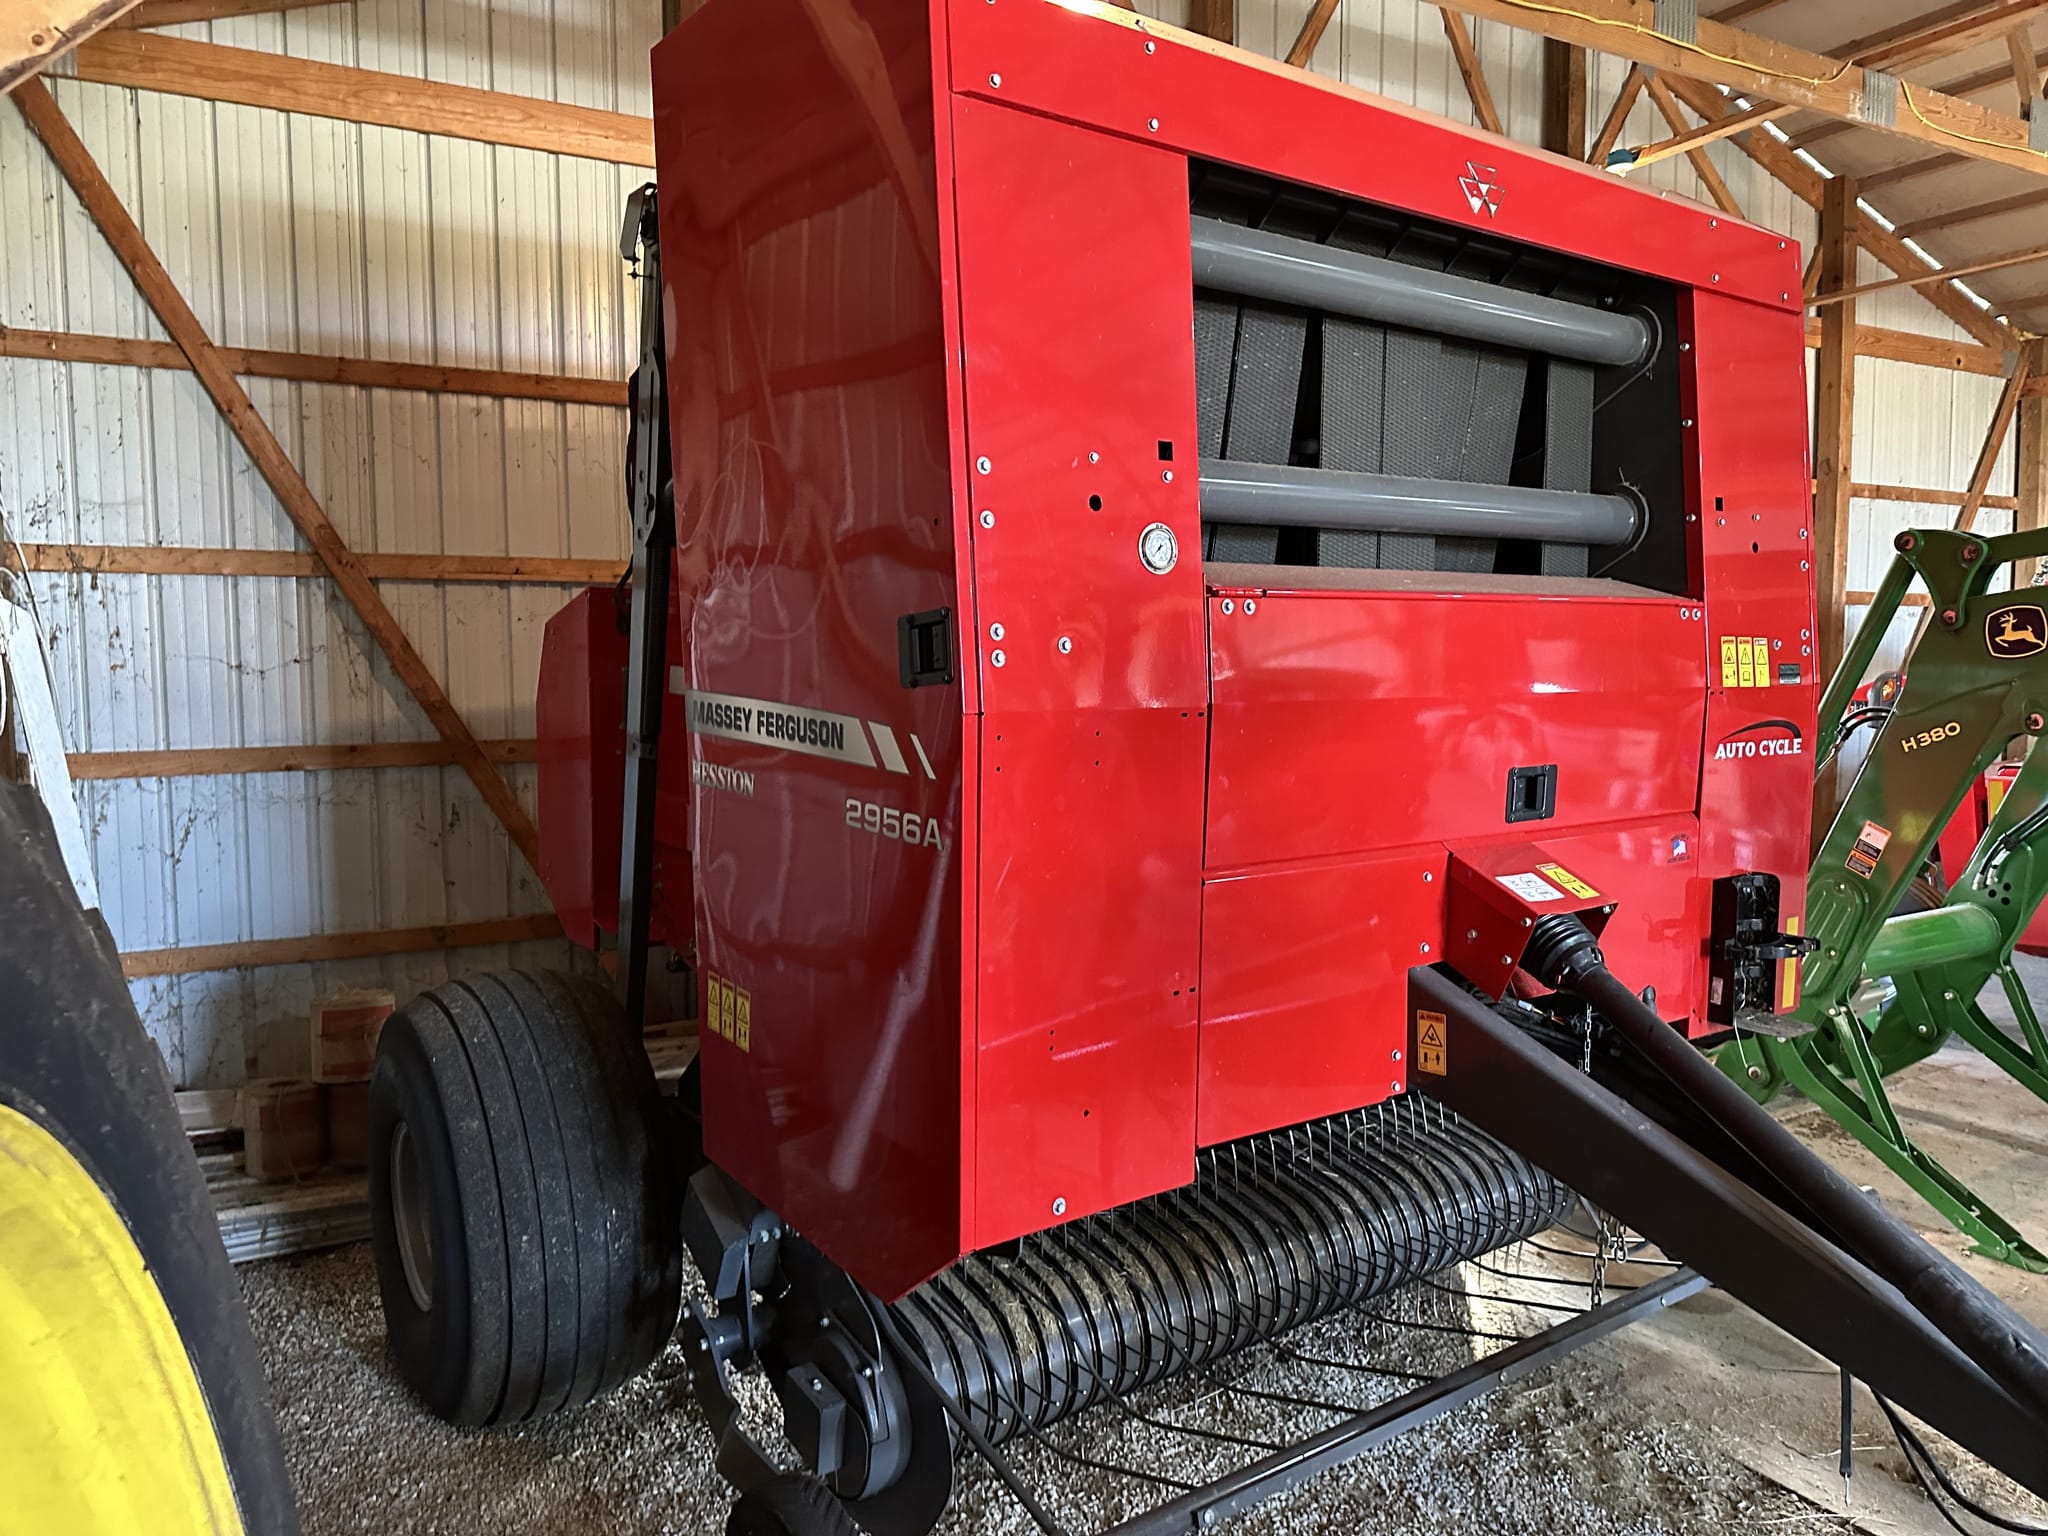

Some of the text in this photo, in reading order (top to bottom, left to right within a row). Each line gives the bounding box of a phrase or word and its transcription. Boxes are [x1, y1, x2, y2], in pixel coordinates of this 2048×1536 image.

[693, 700, 845, 750] MASSEY FERGUSON
[1901, 721, 1961, 754] H380
[1714, 738, 1802, 760] AUTO CYCLE
[692, 760, 755, 797] HESSTON
[846, 799, 943, 850] 2956A
